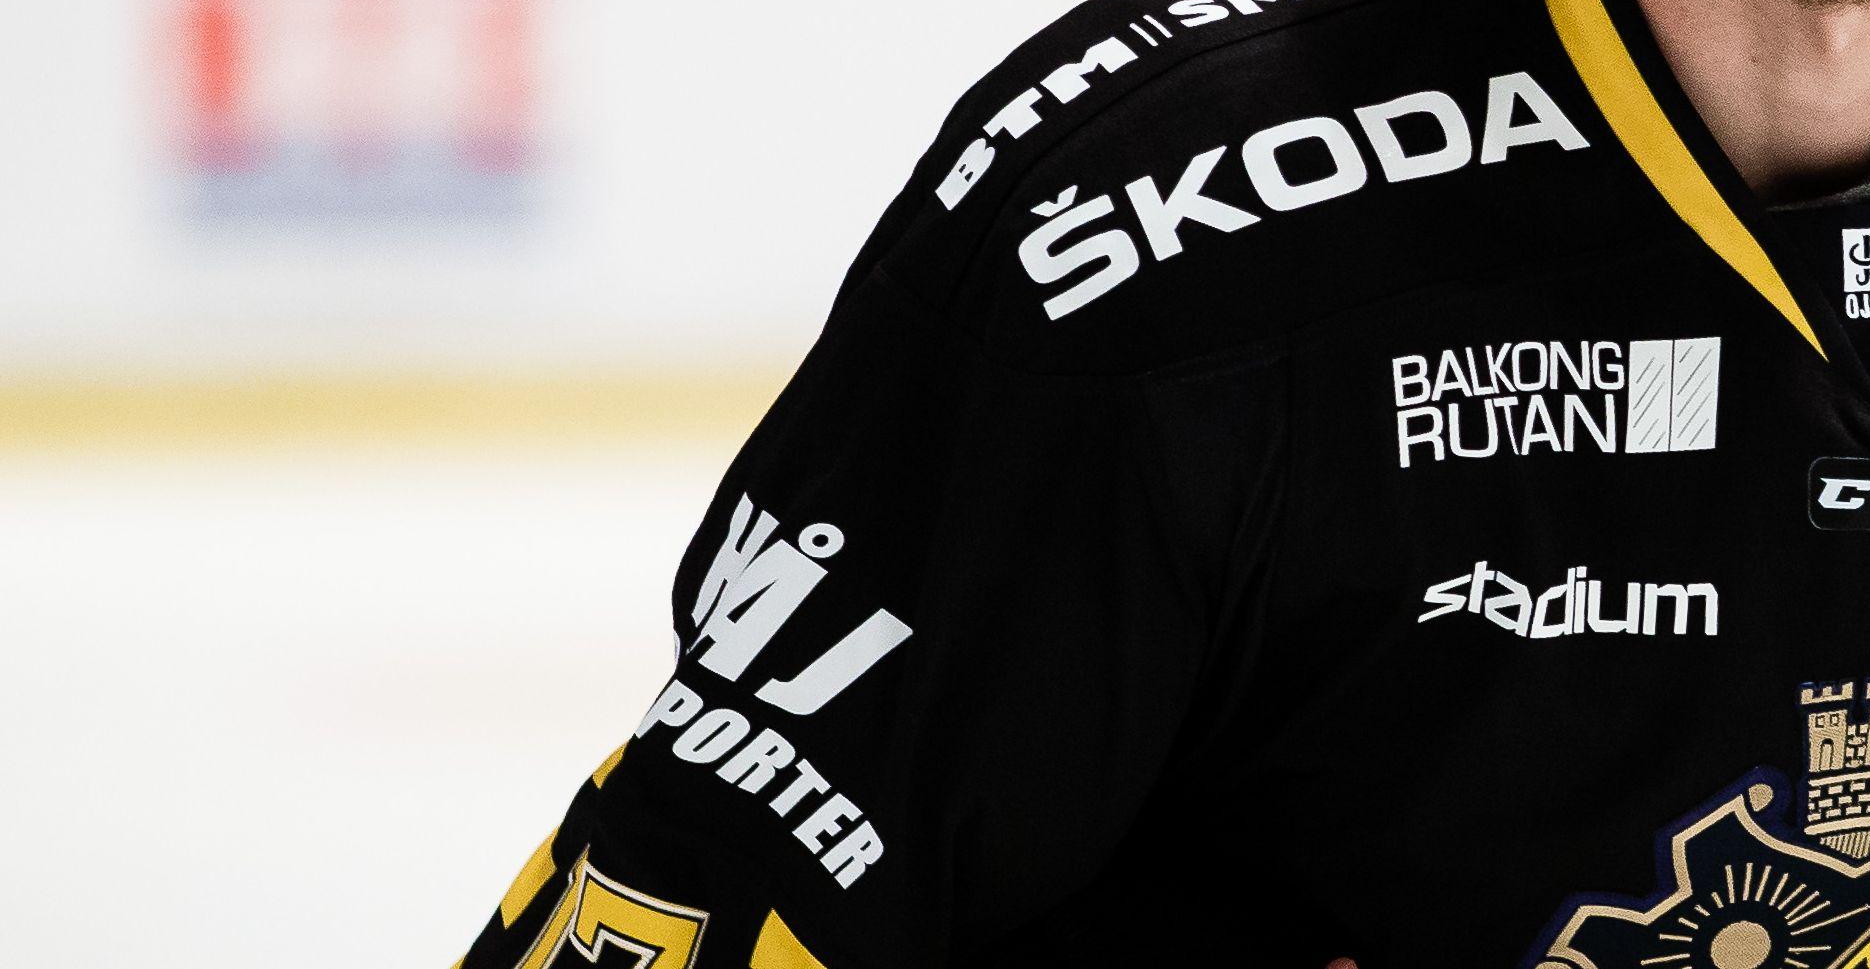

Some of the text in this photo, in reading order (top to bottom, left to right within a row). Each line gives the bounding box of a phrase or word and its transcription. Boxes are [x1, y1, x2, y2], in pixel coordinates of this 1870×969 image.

[1018, 71, 1591, 321] ŠKODA
[1392, 340, 1625, 407] BALKONG
[1396, 393, 1617, 469] RUTAN
[1417, 560, 1719, 639] stadium
